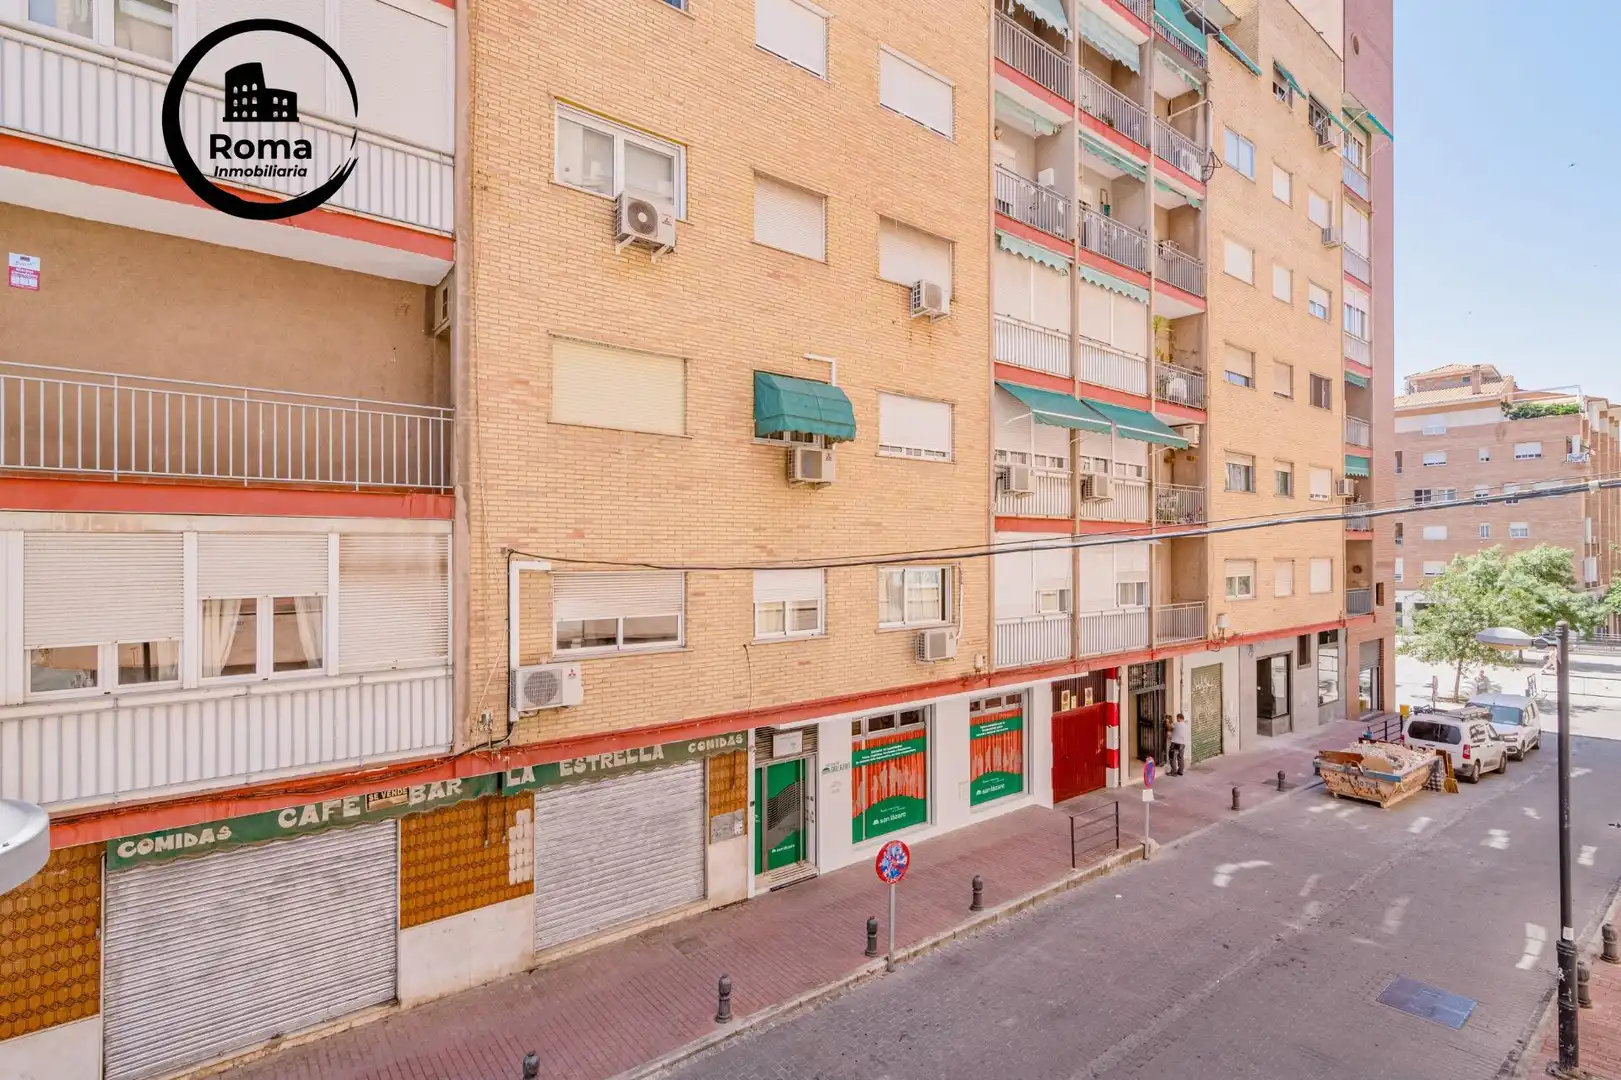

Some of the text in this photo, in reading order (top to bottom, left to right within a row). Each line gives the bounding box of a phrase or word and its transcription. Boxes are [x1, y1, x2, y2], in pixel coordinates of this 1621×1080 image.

[506, 733, 744, 787] LA ESTRELLA COMIDAS
[117, 779, 463, 859] COMIDAS CAFE BAR
[367, 786, 409, 802] SE VENDE
